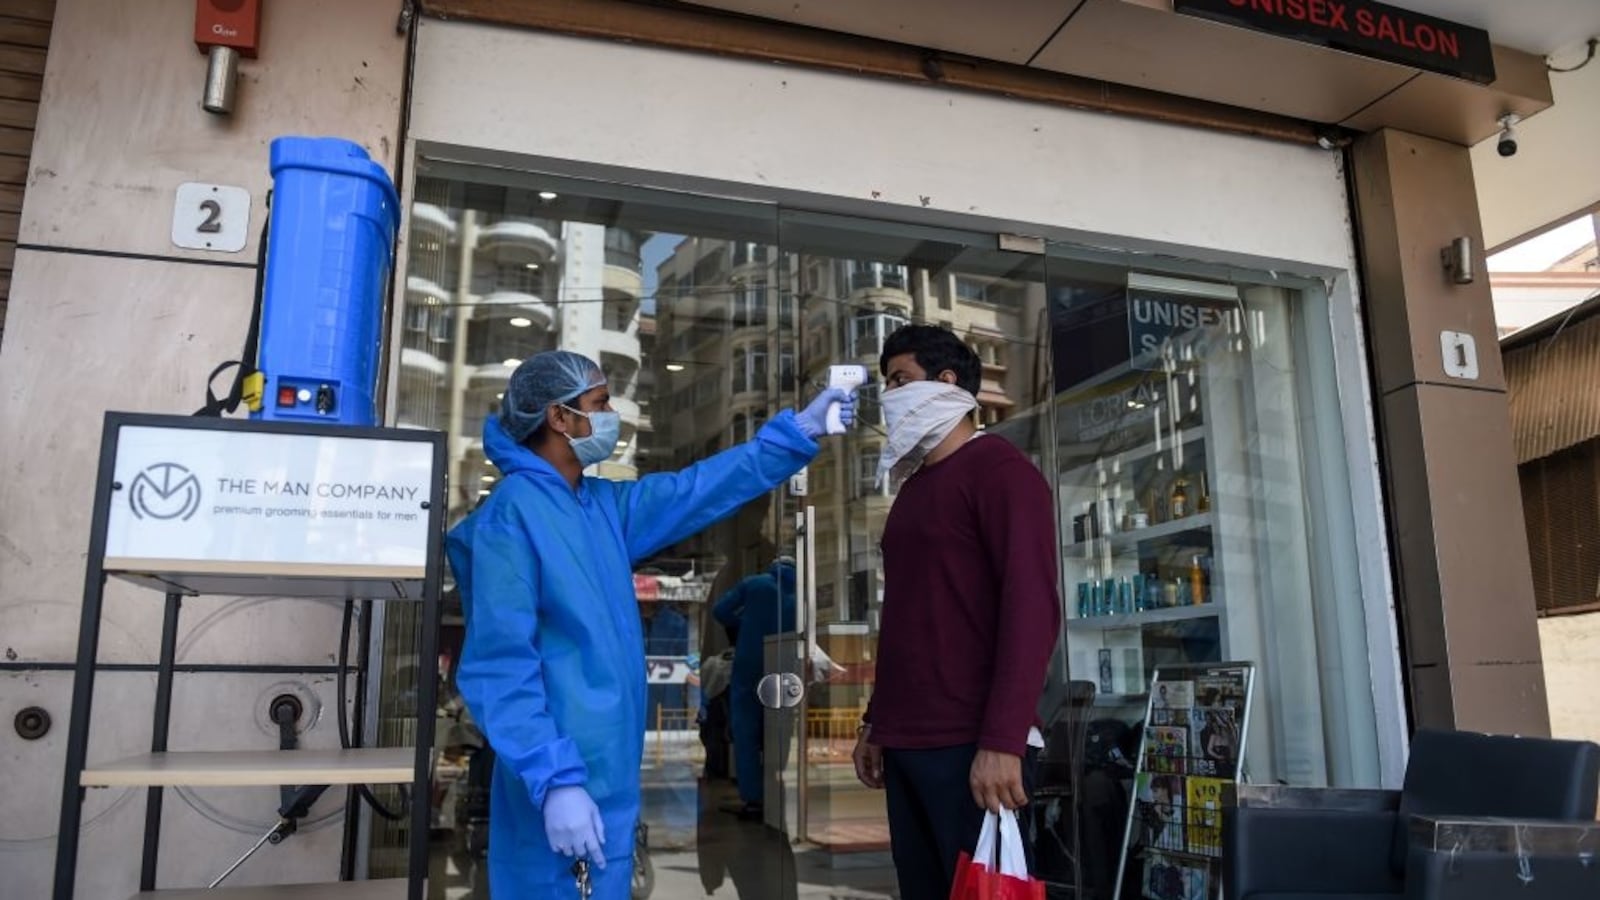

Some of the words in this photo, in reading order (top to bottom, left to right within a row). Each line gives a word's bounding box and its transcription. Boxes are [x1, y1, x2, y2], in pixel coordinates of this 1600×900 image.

[1355, 8, 1460, 58] SALON
[197, 200, 222, 233] 2
[1133, 299, 1229, 328] UNISEX
[1455, 343, 1468, 366] 1
[217, 478, 256, 494] THE
[263, 481, 309, 496] MAN
[316, 483, 418, 501] COMPANY
[212, 505, 262, 516] premium
[321, 509, 373, 520] essentials
[377, 511, 391, 520] for
[394, 512, 418, 521] men
